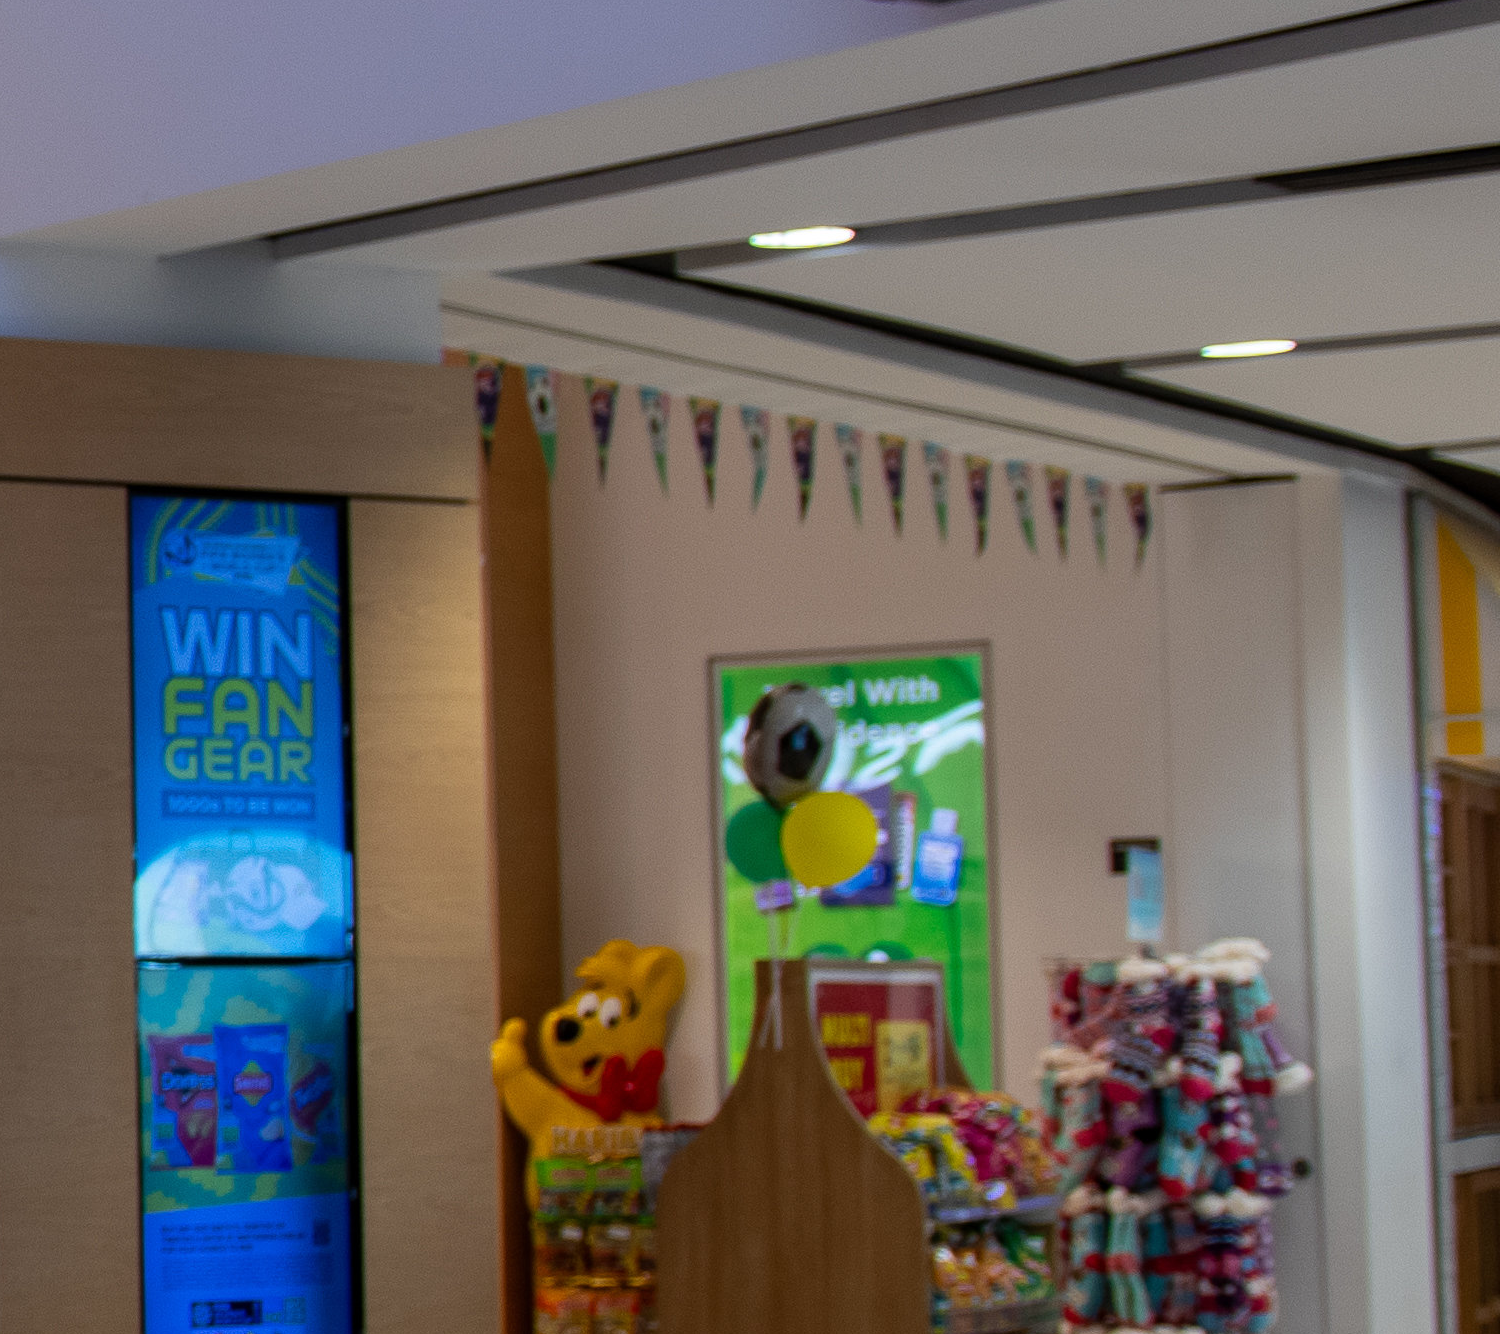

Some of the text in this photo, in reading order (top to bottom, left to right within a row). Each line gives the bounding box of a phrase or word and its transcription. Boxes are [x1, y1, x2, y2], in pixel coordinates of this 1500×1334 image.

[160, 608, 313, 678] WIN
[163, 676, 314, 738] FAN
[863, 675, 940, 705] With
[164, 738, 313, 784] GEAR
